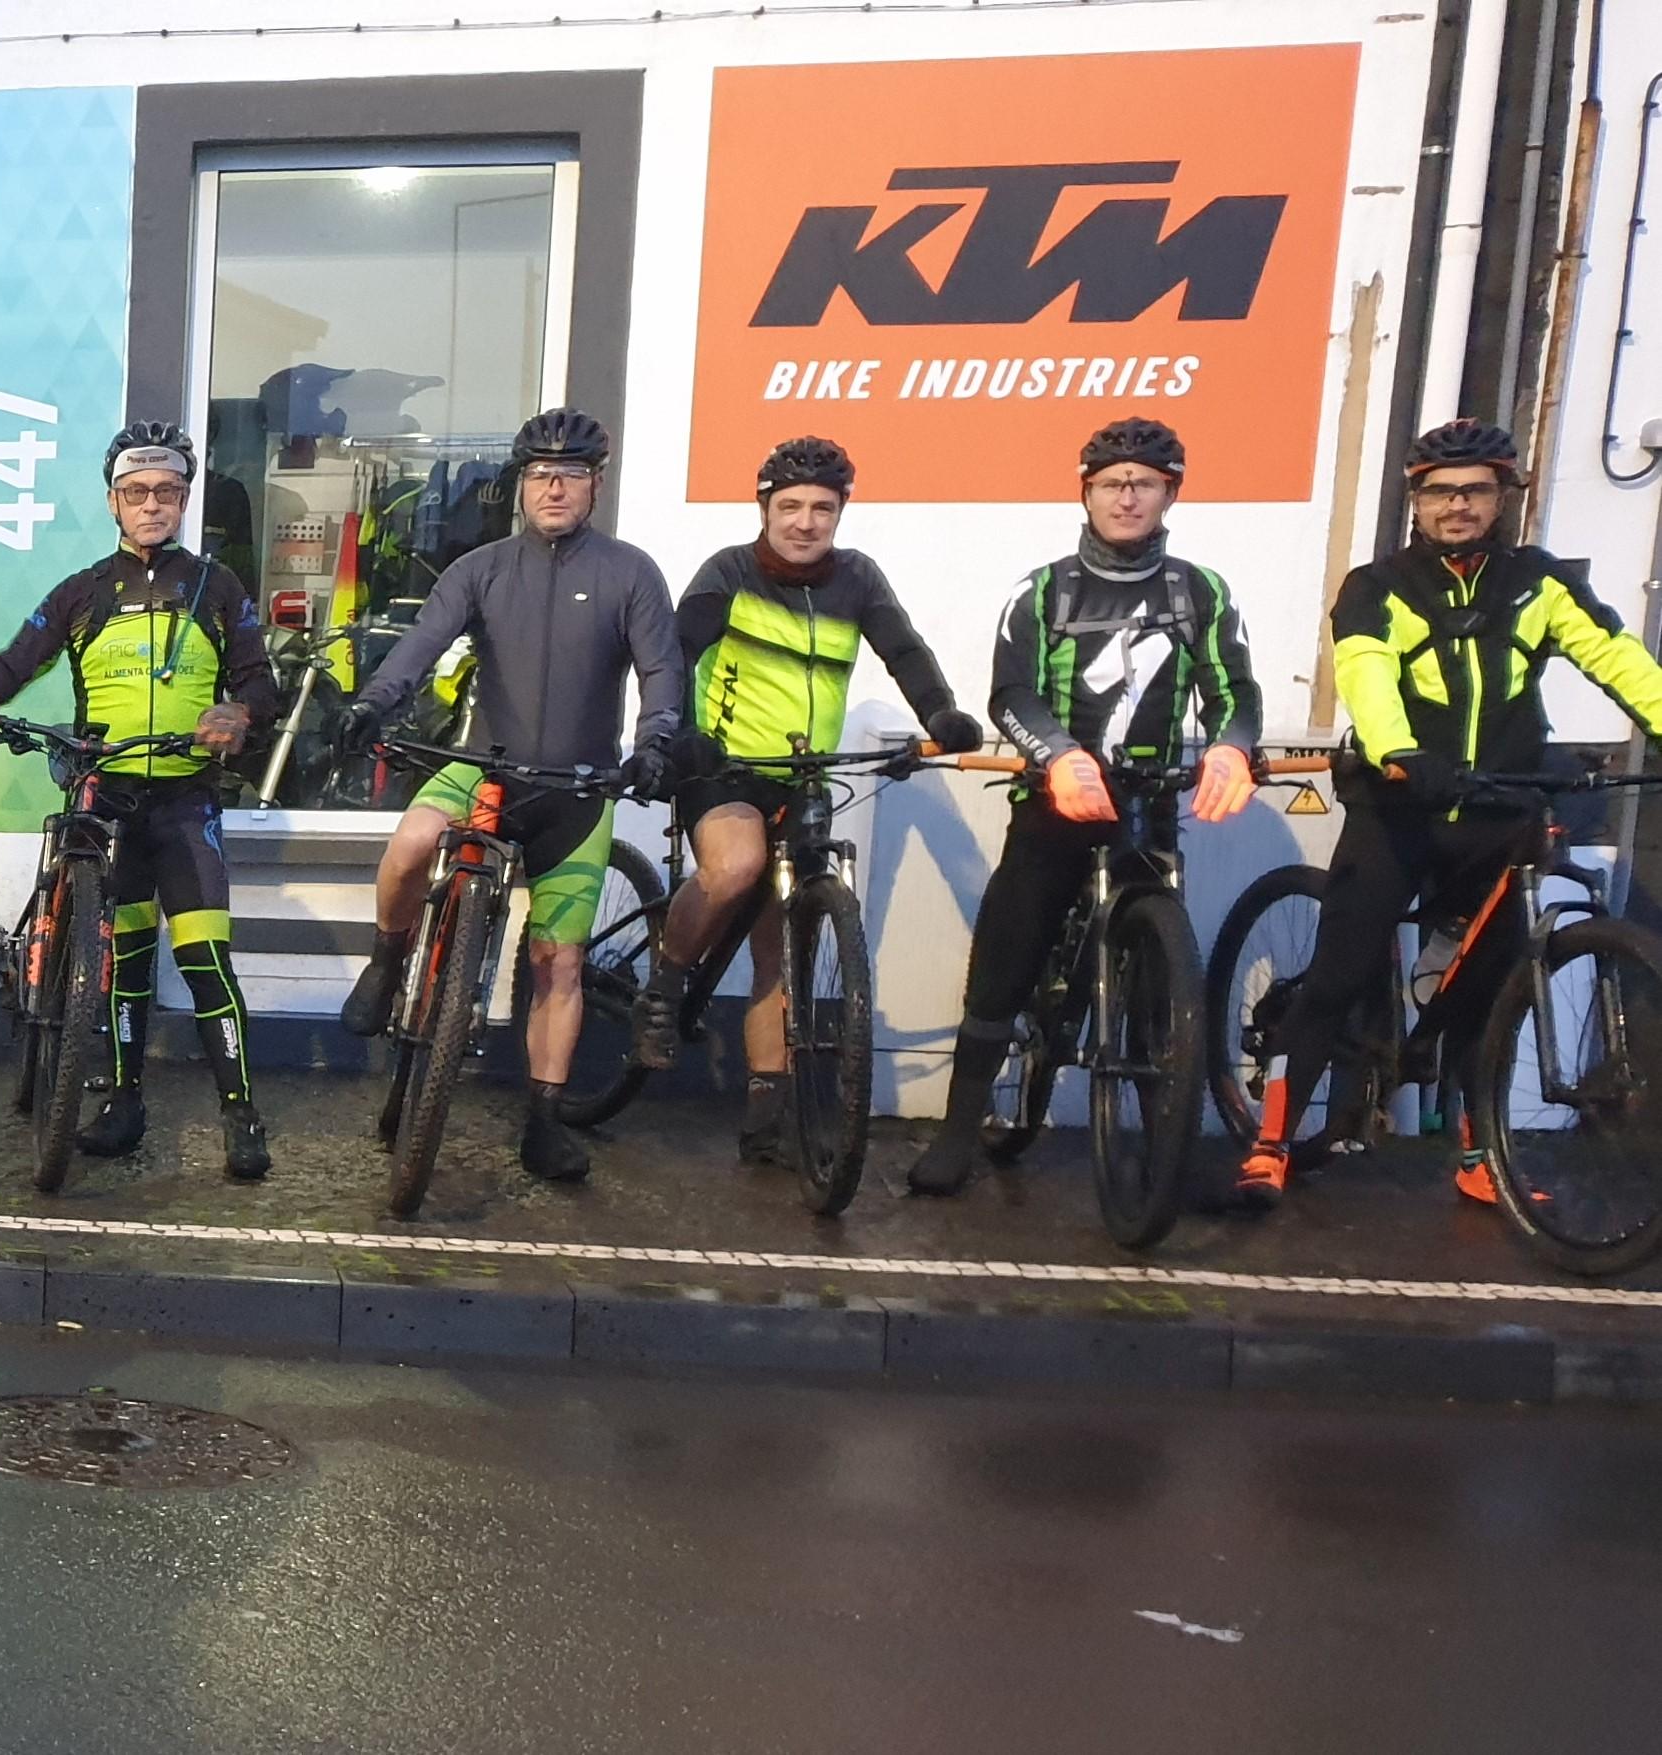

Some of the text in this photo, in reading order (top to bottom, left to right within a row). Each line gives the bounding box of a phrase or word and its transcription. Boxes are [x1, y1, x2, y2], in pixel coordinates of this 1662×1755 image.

[748, 160, 1289, 327] KTM
[764, 355, 1200, 400] BIKE INDUSTRIES
